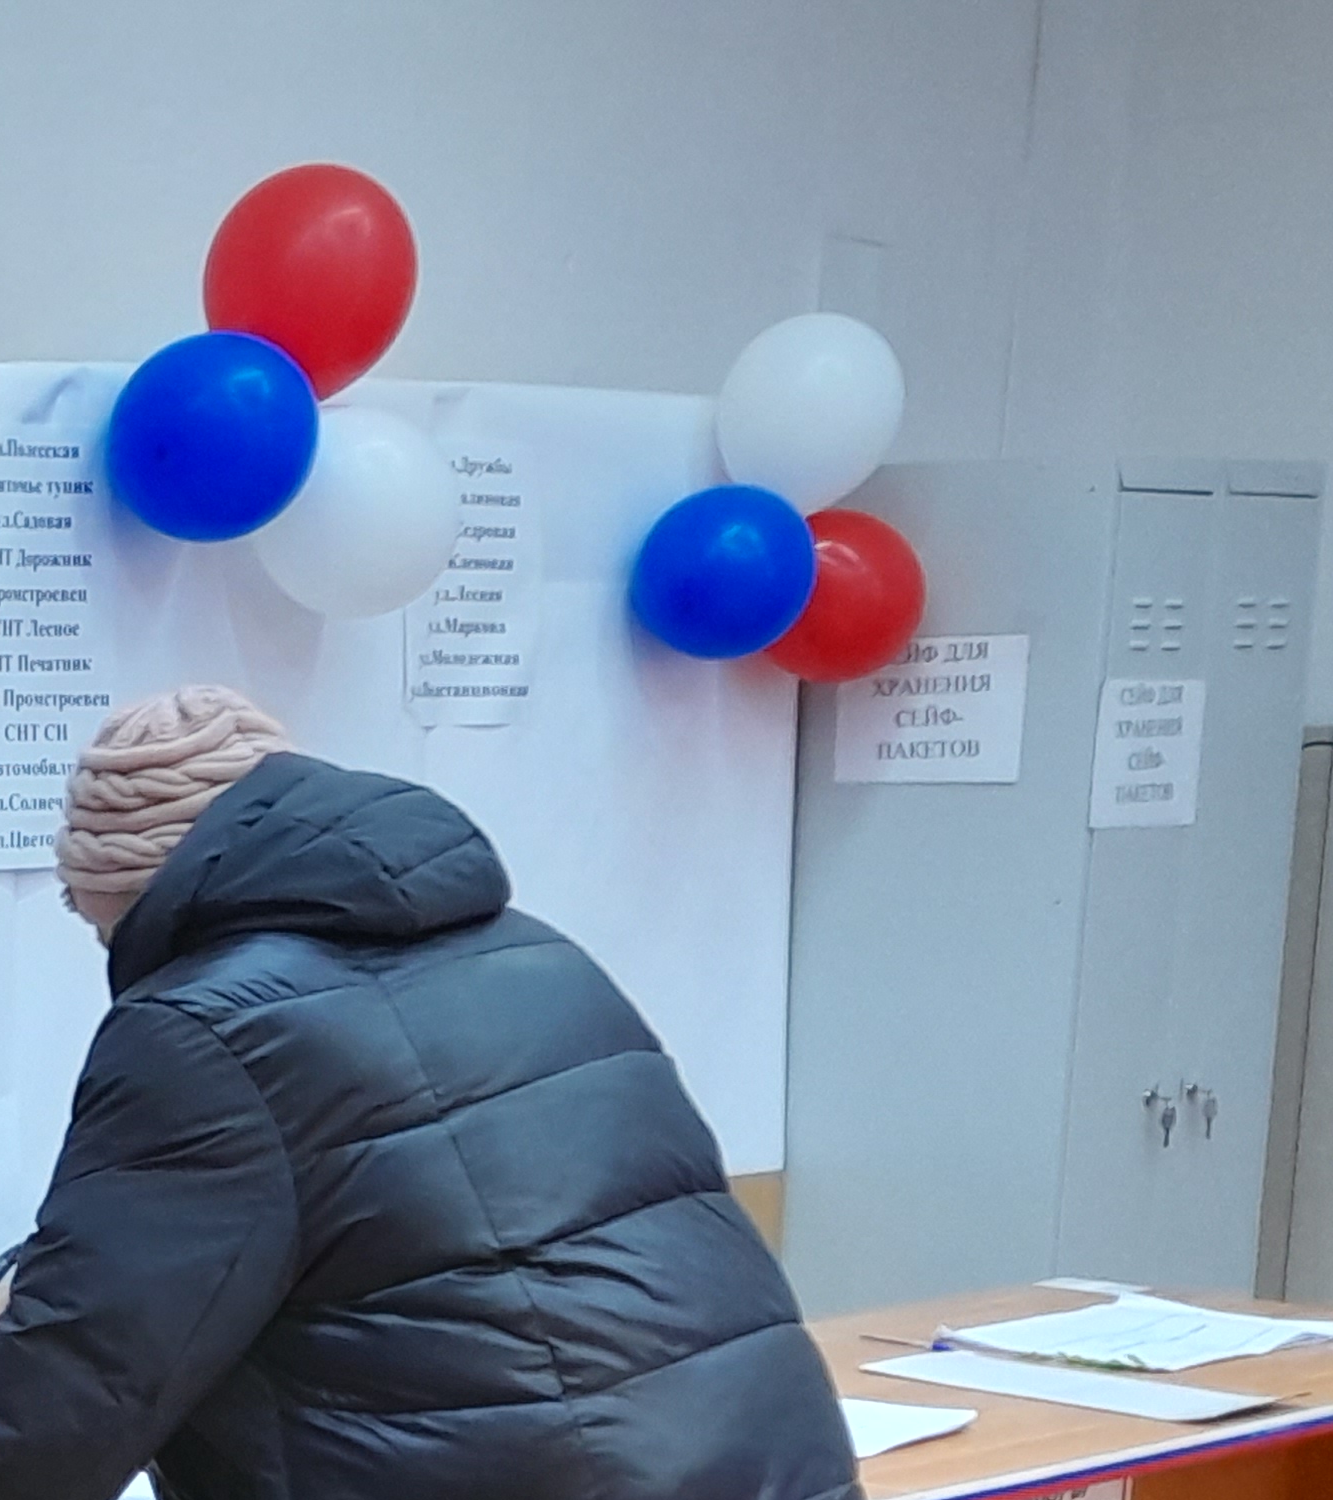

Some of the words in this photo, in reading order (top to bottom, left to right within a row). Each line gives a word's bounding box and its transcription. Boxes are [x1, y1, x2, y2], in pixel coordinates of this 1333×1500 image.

[46, 480, 94, 499] тупик
[15, 548, 93, 573] Дорожник
[25, 619, 81, 638] Лесное
[943, 641, 990, 663] ДЛЯ
[17, 655, 92, 673] Печатник
[872, 674, 991, 697] ХРАНЕНИЯ
[3, 689, 110, 712] Промстроевец
[895, 705, 964, 728] СЕЙФ-
[4, 723, 39, 742] СНТ
[877, 739, 981, 760] ПАКЕТОВ
